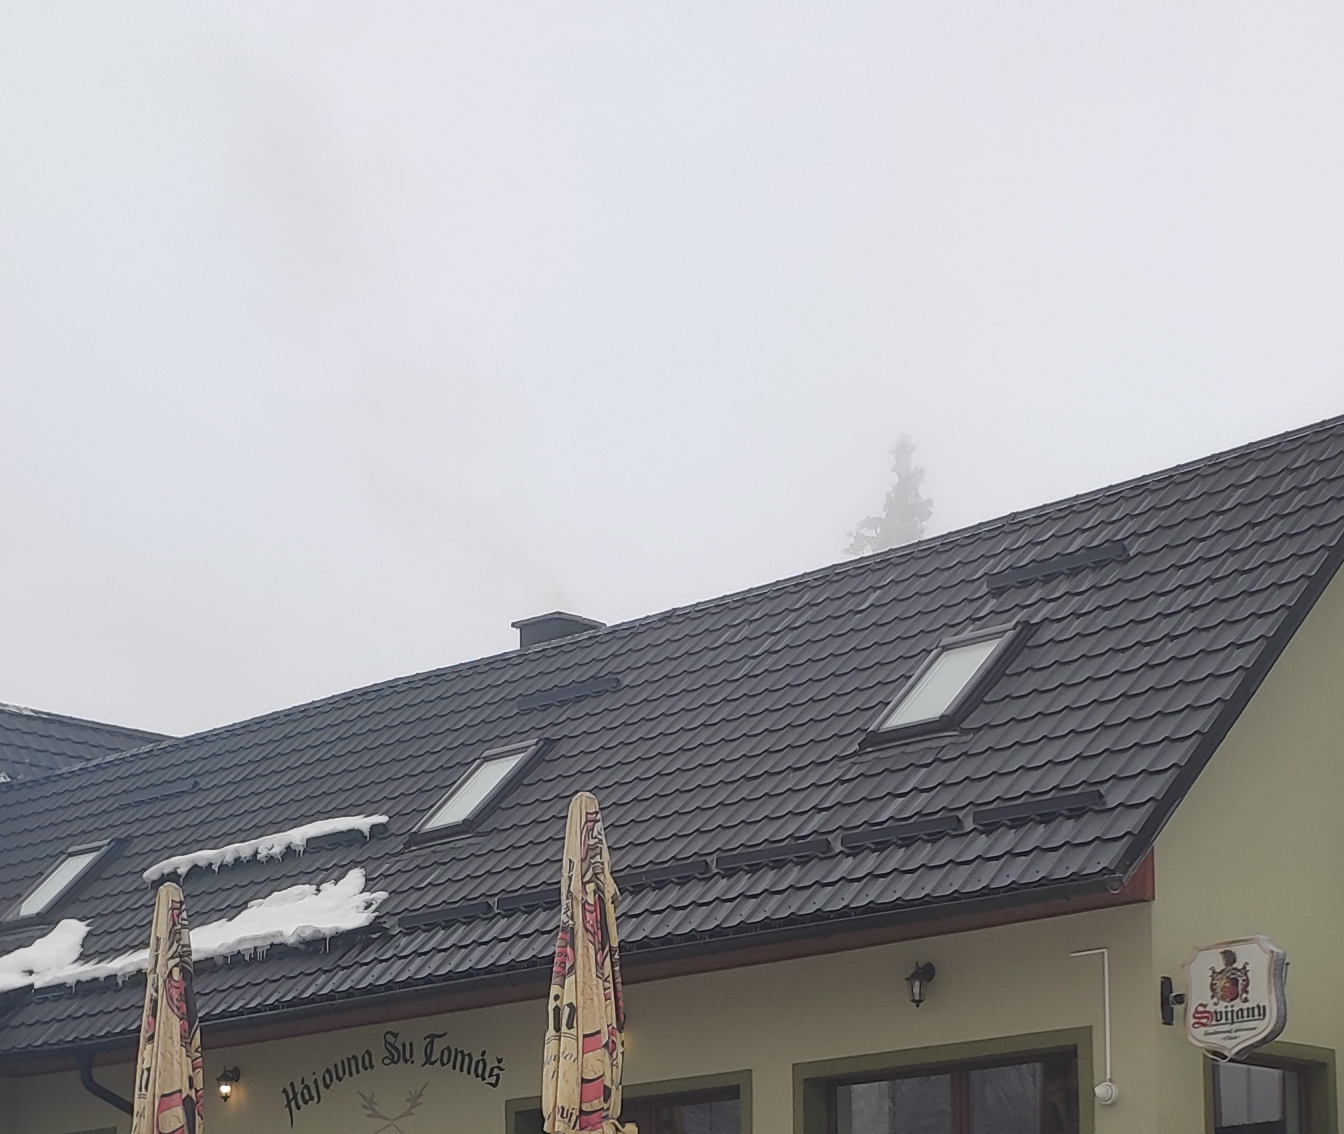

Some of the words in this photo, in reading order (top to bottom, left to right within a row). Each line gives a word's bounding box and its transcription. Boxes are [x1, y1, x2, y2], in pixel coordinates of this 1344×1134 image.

[1192, 1003, 1266, 1029] Svijany
[281, 1049, 375, 1129] Hájovna
[421, 1032, 506, 1089] Tomáš
